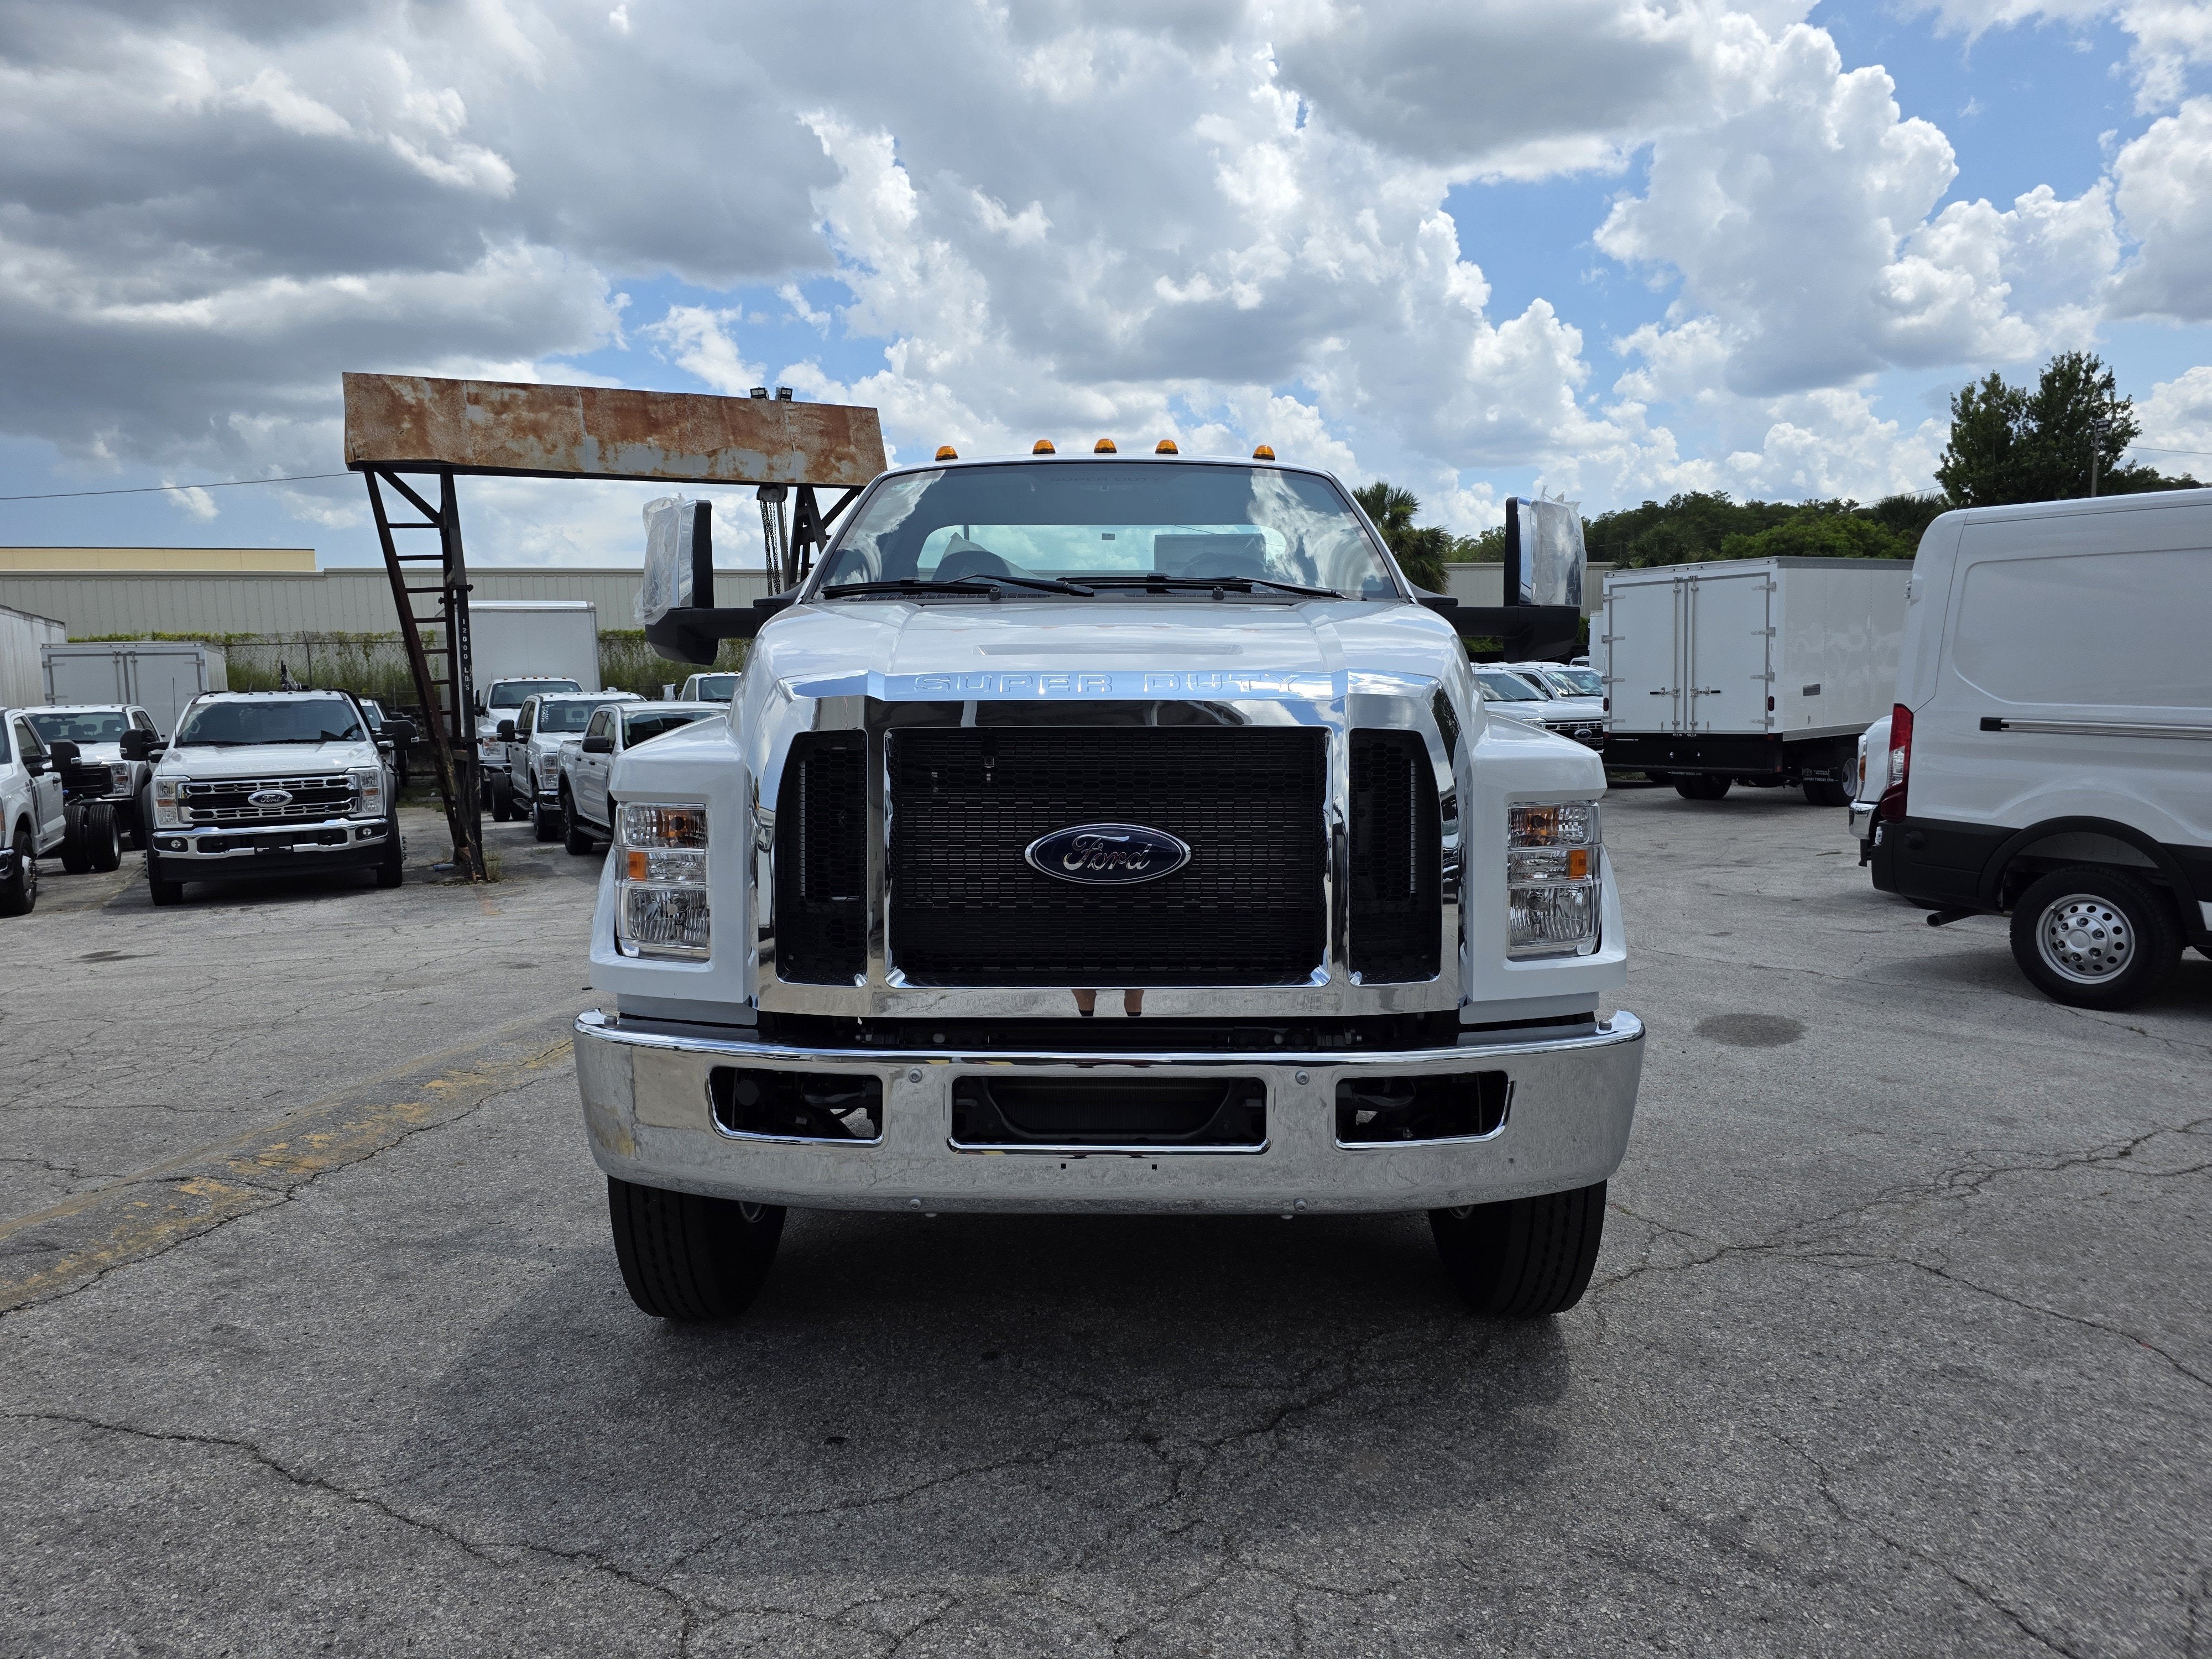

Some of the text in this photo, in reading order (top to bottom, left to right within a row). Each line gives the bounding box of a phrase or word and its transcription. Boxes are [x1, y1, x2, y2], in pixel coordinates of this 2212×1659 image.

[914, 674, 1301, 692] SUPER DUTY
[260, 795, 281, 803] Ford
[1063, 834, 1152, 870] Ford
